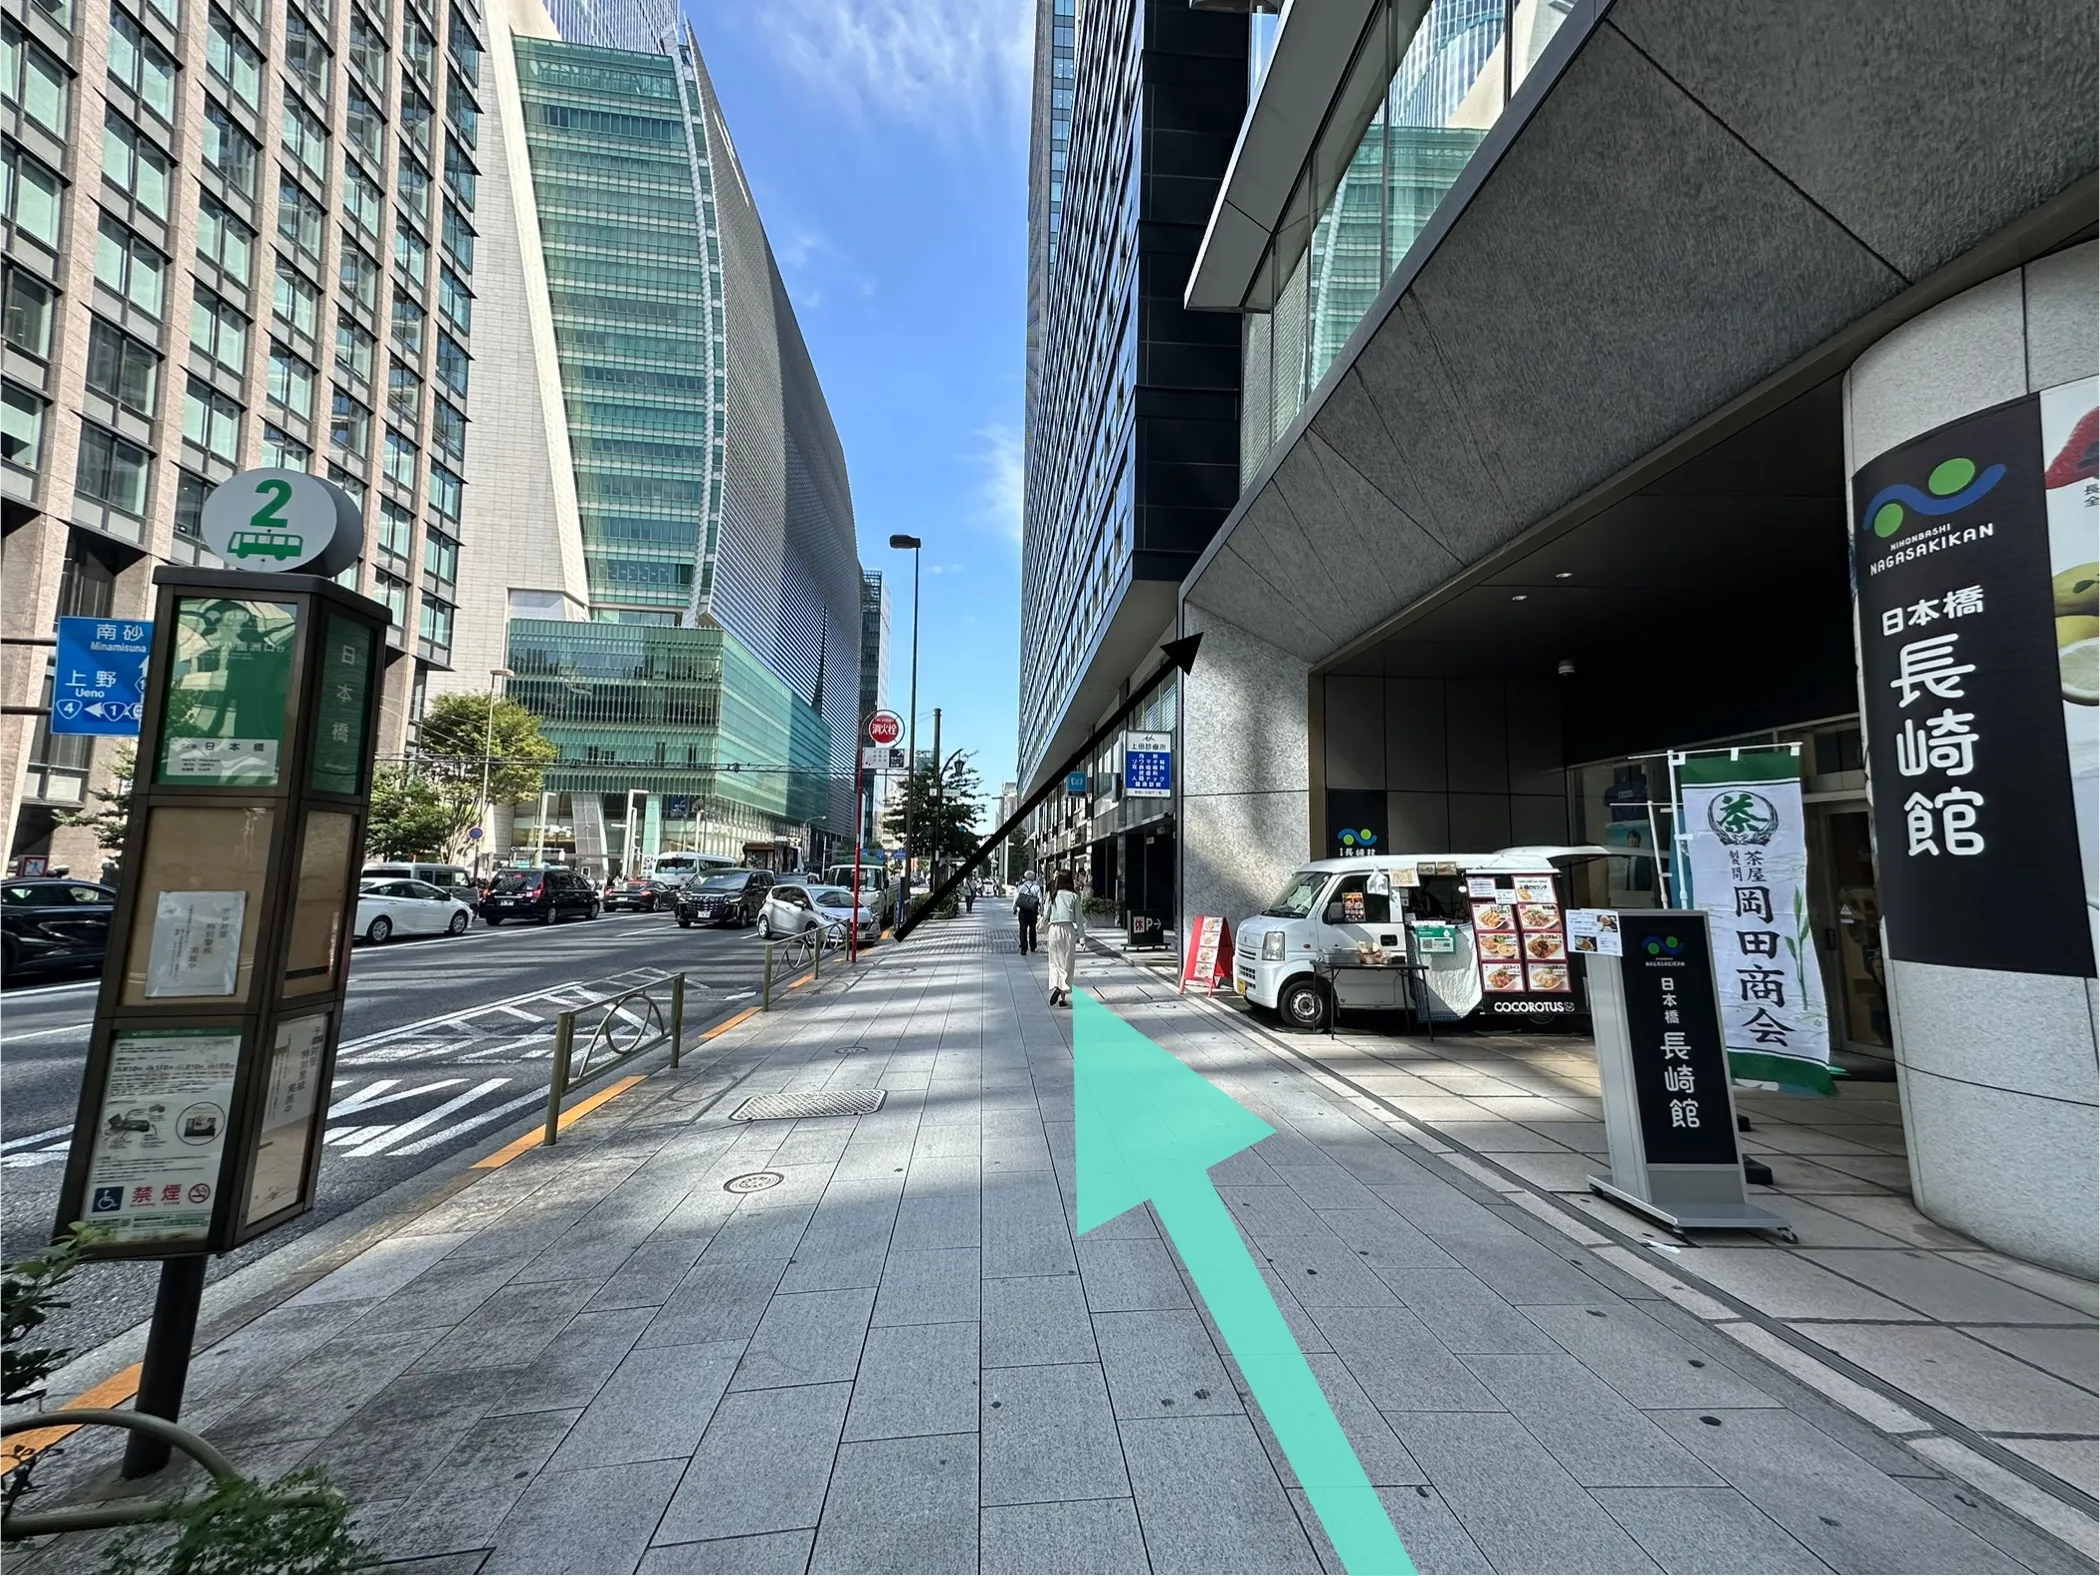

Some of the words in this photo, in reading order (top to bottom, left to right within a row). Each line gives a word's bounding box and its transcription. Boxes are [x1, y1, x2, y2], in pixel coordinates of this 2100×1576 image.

[250, 478, 292, 528] 2
[1870, 522, 1994, 576] NAGASAKIKAN
[1890, 523, 1951, 552] NIHONBASHI
[1881, 584, 1984, 637] 日本橋
[96, 623, 144, 641] 南砂
[90, 641, 147, 653] Minamisuna
[65, 669, 117, 688] 上野
[75, 688, 105, 698] Ueno
[331, 645, 356, 743] 日本橋
[64, 702, 74, 713] 4
[110, 705, 117, 716] 1
[872, 723, 897, 735] 消火栓
[1890, 632, 1986, 857] 長崎館
[1717, 793, 1770, 834] 茶
[1146, 918, 1153, 931] P
[1734, 885, 1796, 1047] 岡田商会
[1494, 1001, 1564, 1013] COCOROTUS
[1661, 977, 1681, 1024] 日本橋
[1660, 1031, 1701, 1129] 長崎館
[131, 1184, 182, 1203] 禁煙
